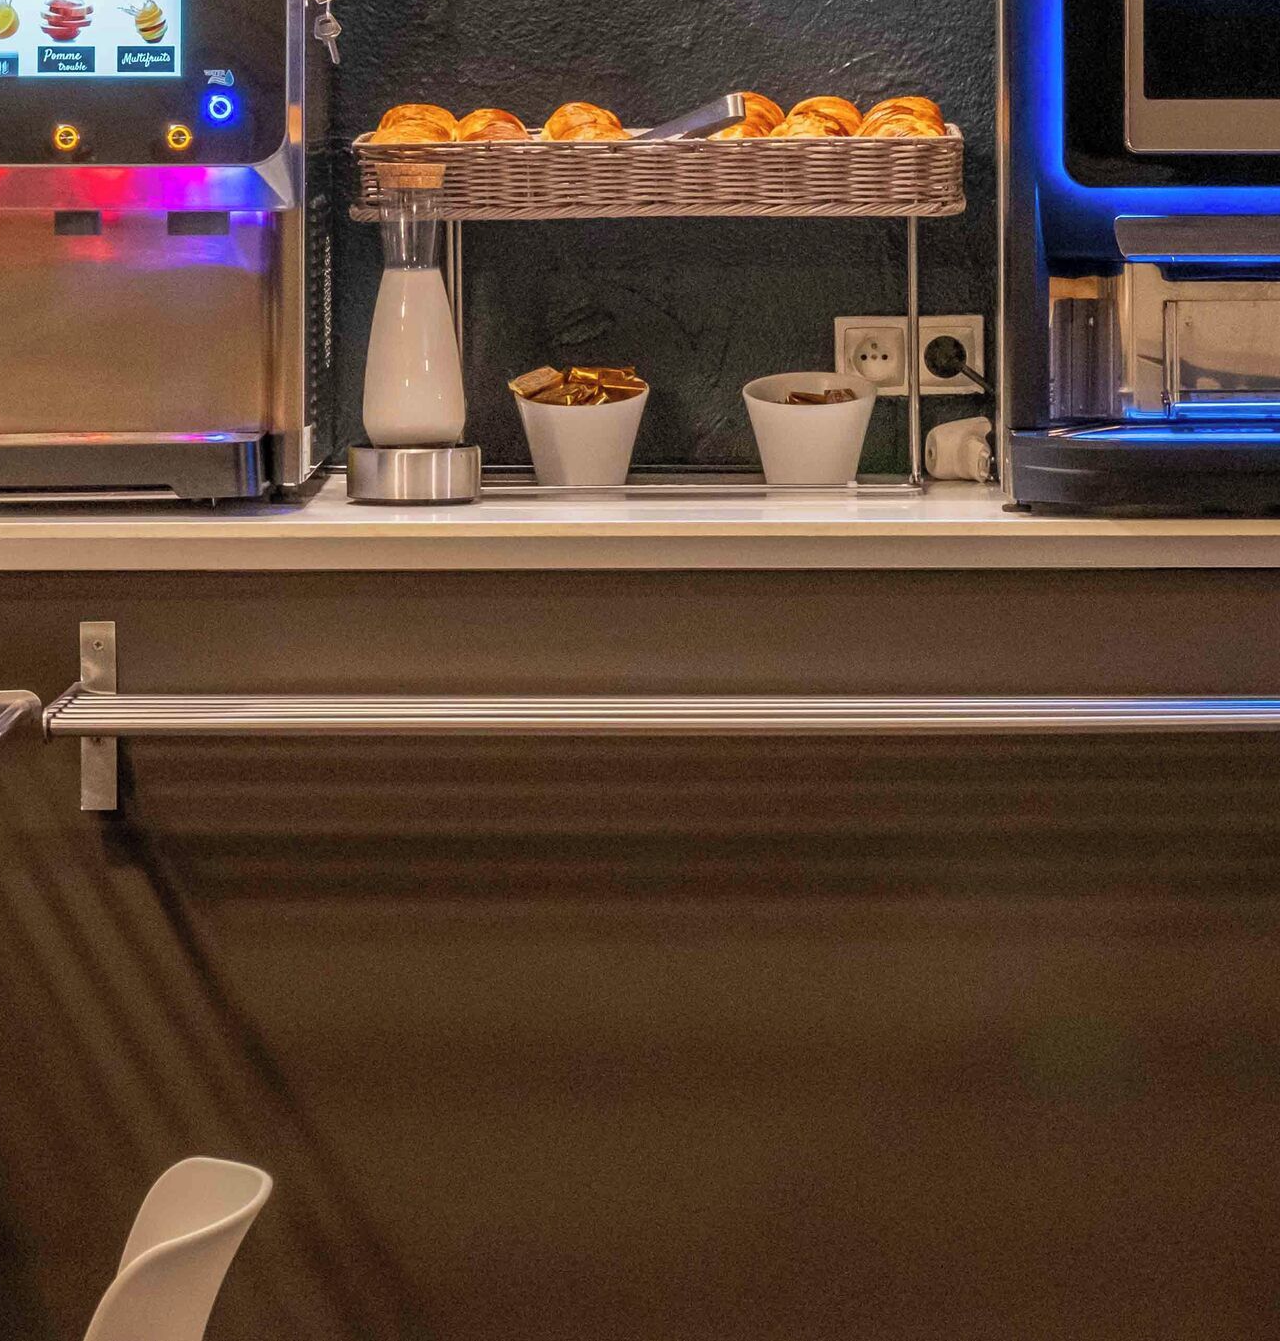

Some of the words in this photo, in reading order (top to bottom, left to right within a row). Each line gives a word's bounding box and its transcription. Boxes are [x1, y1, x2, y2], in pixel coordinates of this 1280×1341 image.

[43, 48, 82, 62] Pomme
[121, 52, 171, 67] Multifruits
[58, 62, 87, 71] trouble
